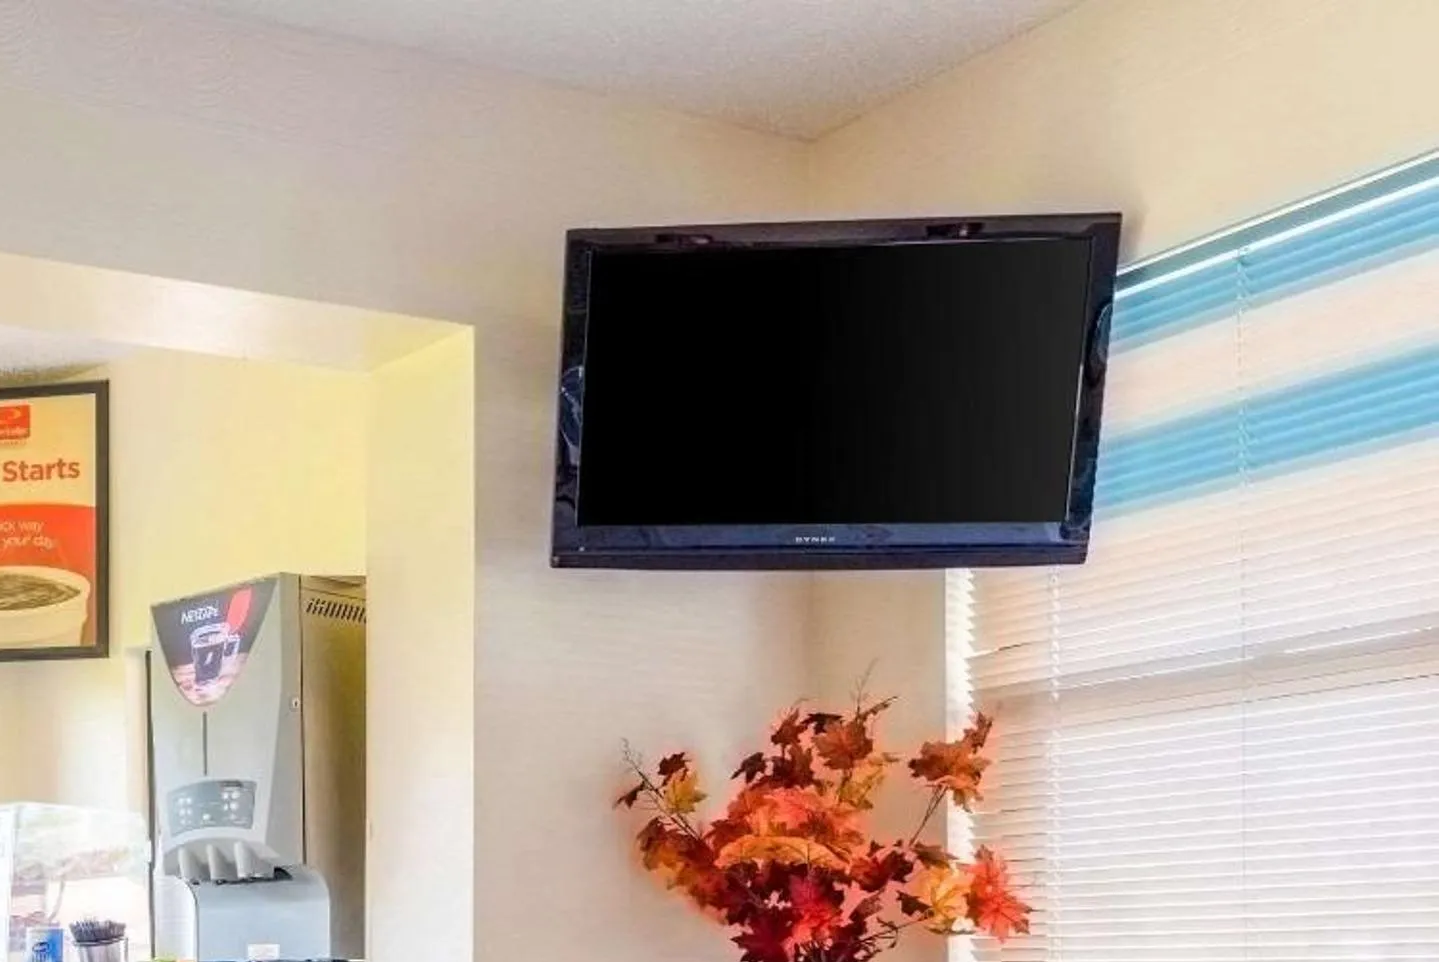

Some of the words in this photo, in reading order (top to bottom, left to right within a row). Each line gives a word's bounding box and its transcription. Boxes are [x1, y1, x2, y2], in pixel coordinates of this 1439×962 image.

[2, 458, 81, 482] Starts
[18, 520, 44, 534] way
[2, 535, 31, 551] your
